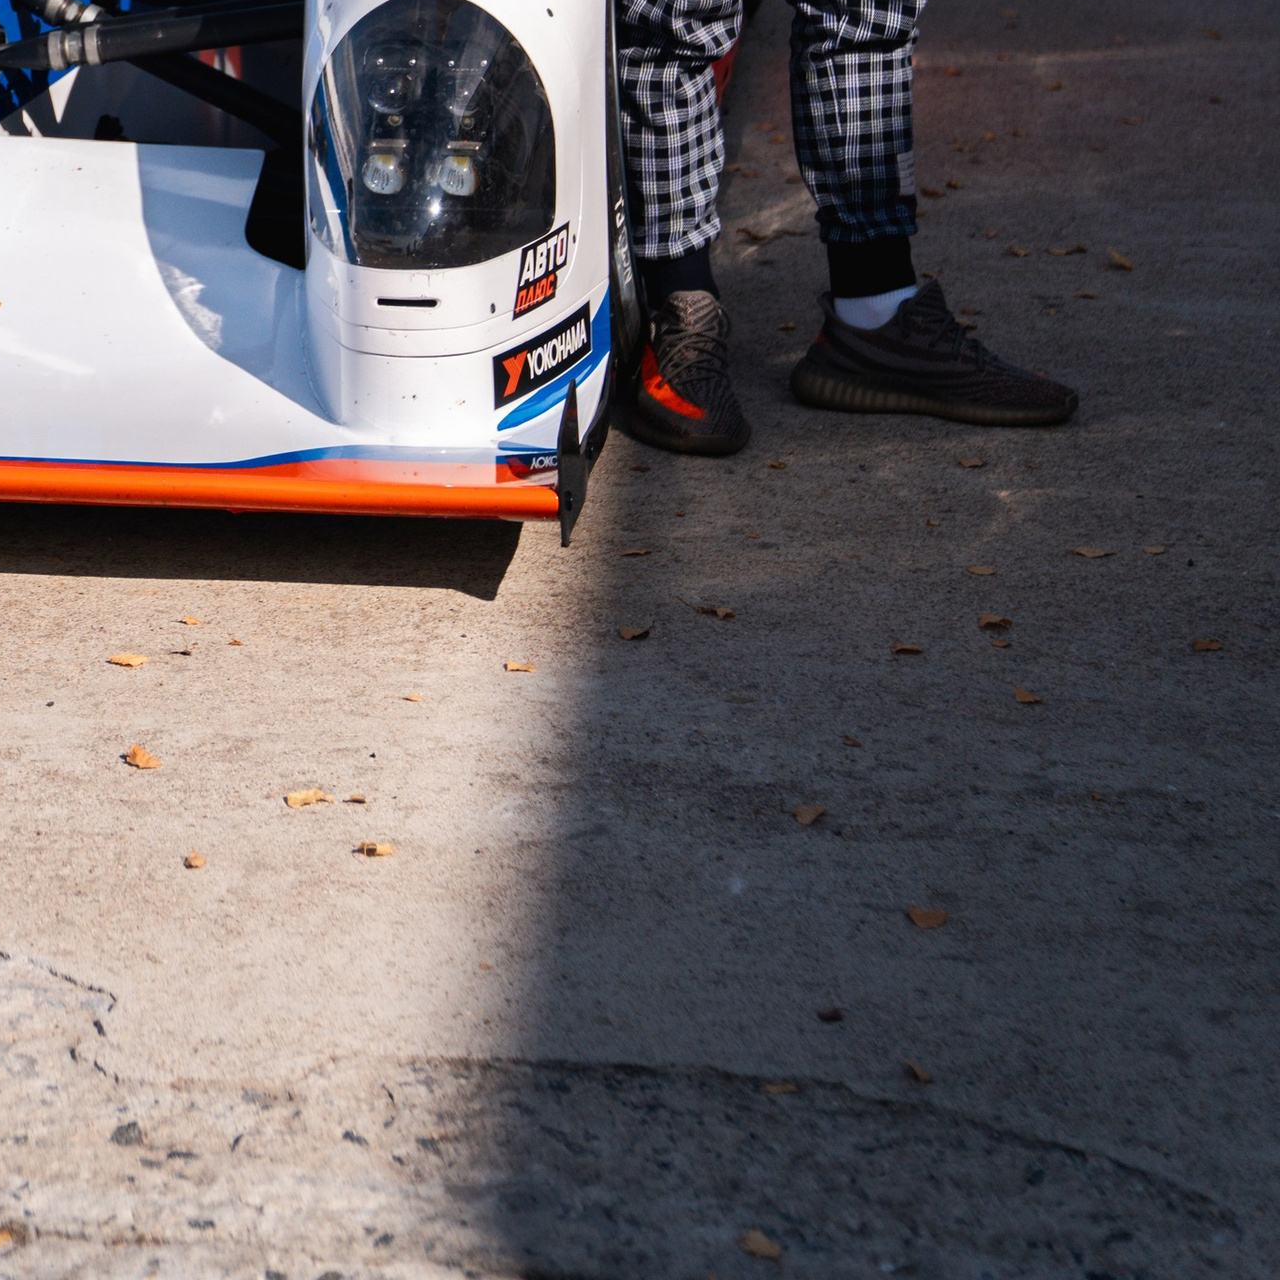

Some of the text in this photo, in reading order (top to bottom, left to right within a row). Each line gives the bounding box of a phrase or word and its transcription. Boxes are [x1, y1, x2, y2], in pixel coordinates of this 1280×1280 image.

[519, 229, 568, 287] АВТО
[515, 273, 555, 313] ПЛЮС
[527, 318, 587, 379] YOKOHAMA
